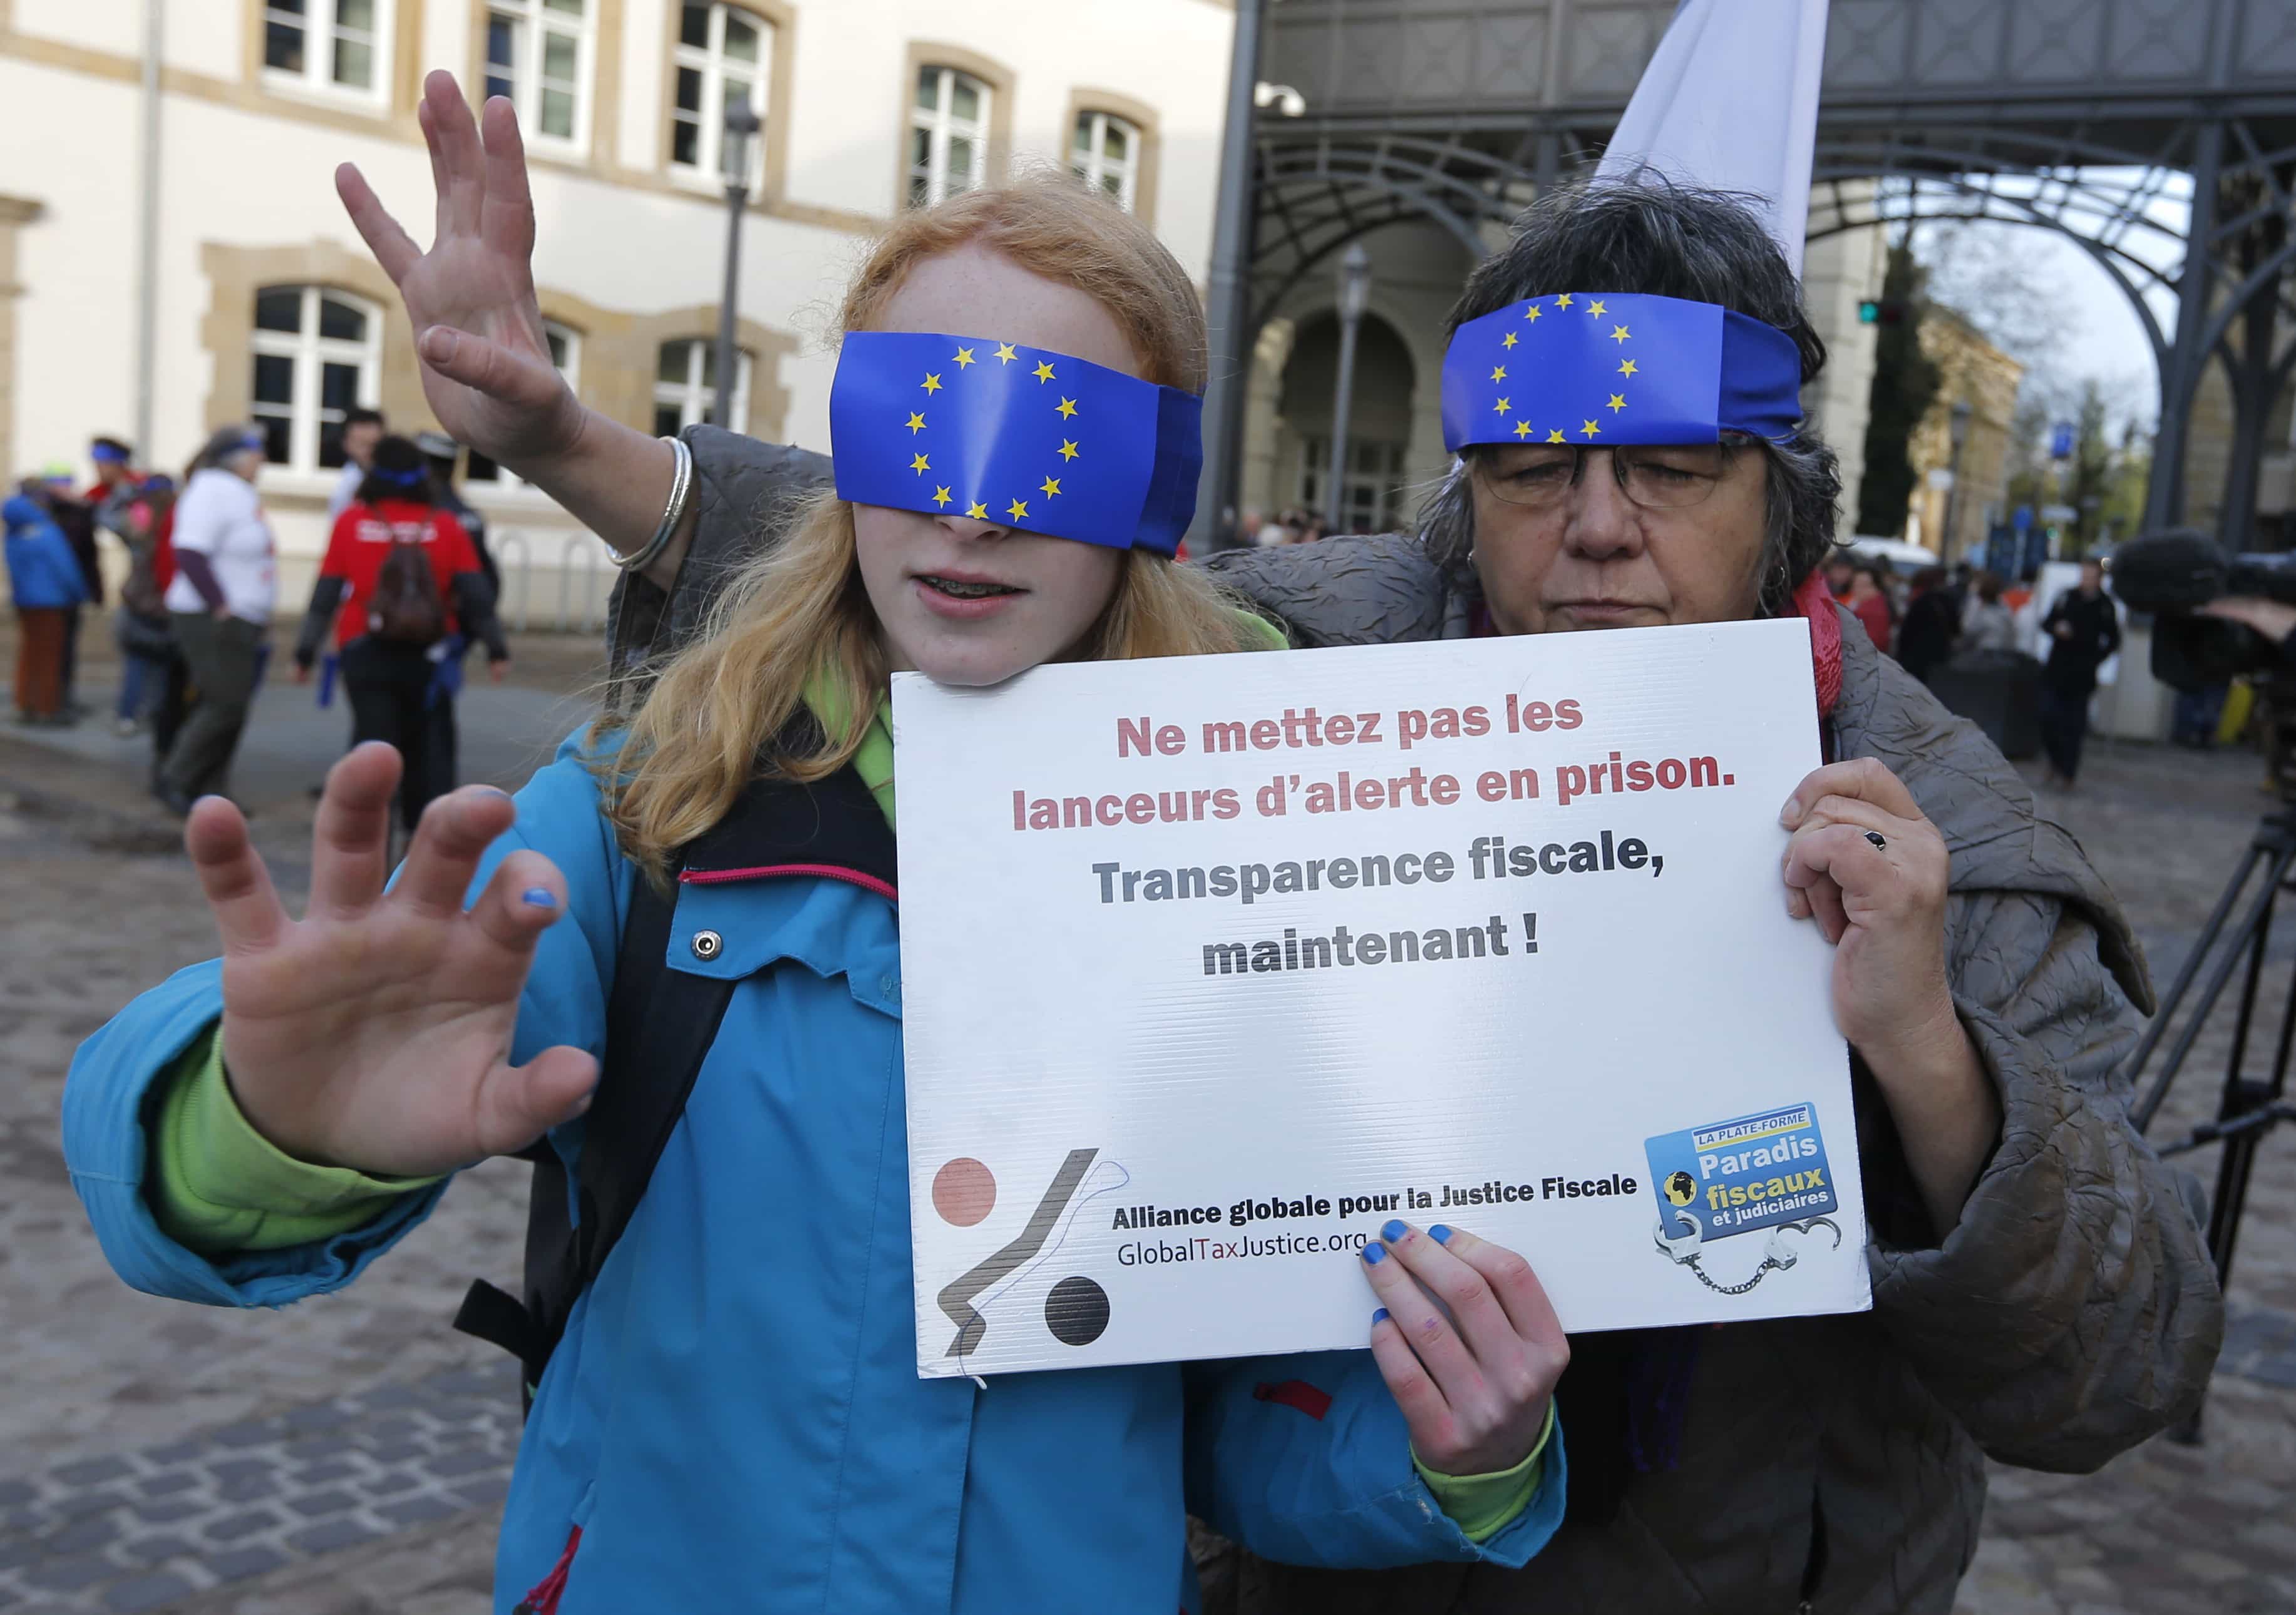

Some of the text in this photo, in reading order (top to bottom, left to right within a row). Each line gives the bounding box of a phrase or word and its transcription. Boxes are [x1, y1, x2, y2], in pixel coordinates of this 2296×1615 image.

[1118, 694, 1583, 757] Ne mettez pas les
[1013, 789, 1240, 830] lanceurs
[1476, 769, 1540, 802] en
[1557, 751, 1735, 806] prison.
[1092, 830, 1664, 904] Transparence fiscale,
[1203, 913, 1538, 975] maintenant !
[1699, 1112, 1806, 1145] LA PLATE-FORME
[1699, 1135, 1818, 1180] Paradis
[1112, 1173, 1637, 1230] Alliance globale pour la Justice Fiscale
[1706, 1168, 1825, 1211] fiscaux
[1712, 1191, 1829, 1226] et judiciaires
[1118, 1233, 1367, 1265] GlobalTaxJustice.org
